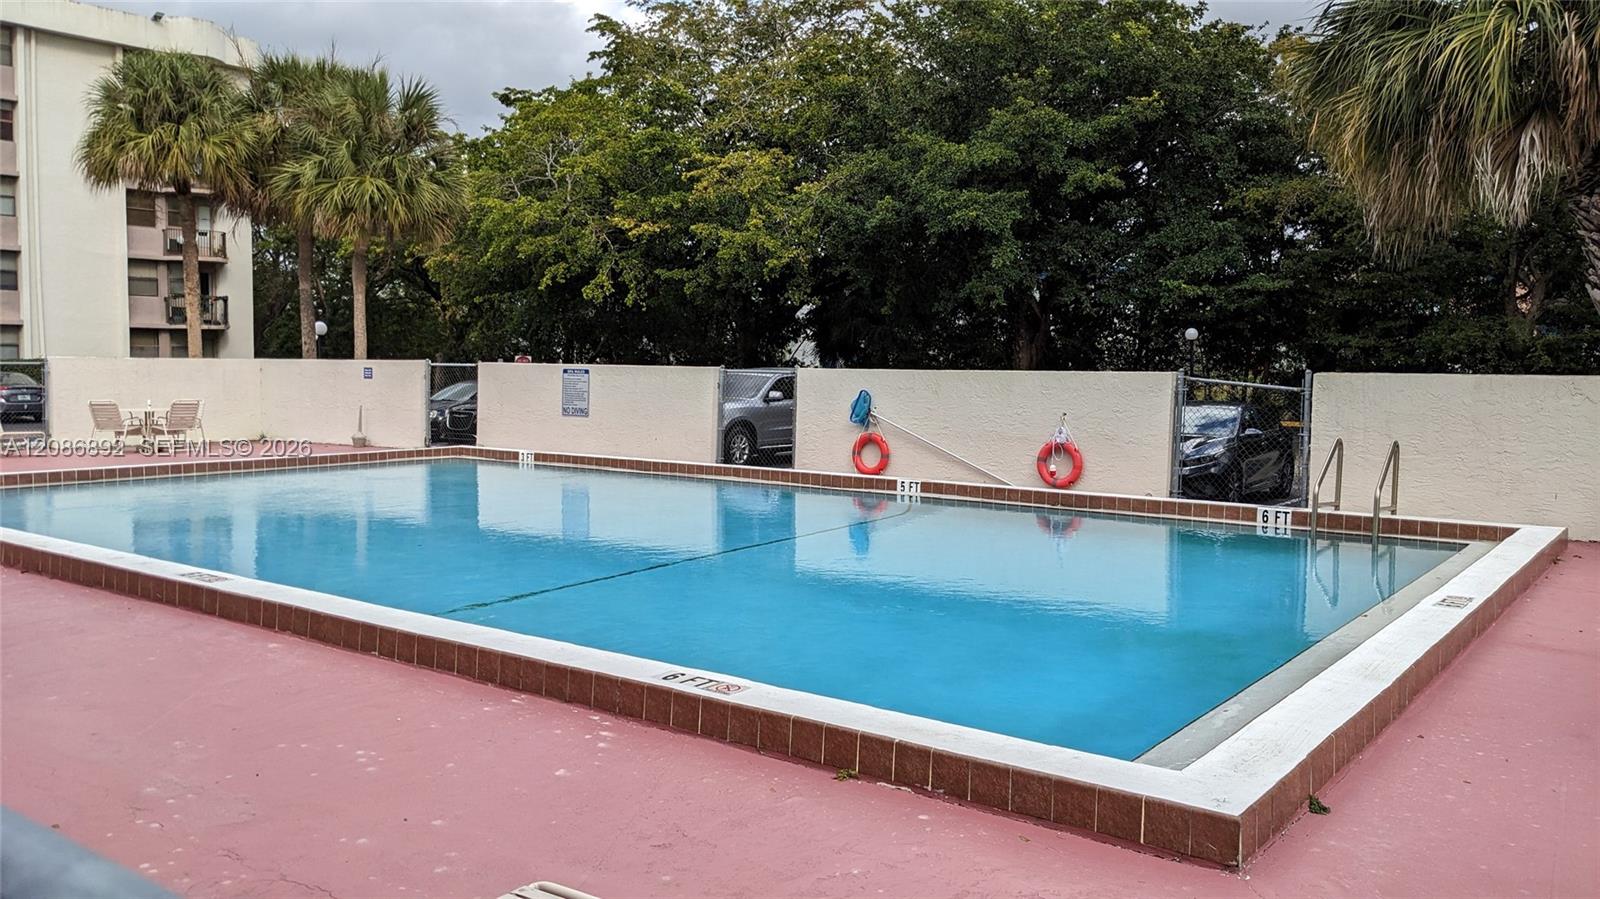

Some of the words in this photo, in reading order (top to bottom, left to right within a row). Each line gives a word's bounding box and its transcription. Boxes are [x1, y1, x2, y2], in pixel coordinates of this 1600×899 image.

[563, 407, 571, 415] NO
[571, 407, 589, 416] DIVING
[526, 452, 534, 462] FT
[900, 480, 906, 492] 5
[909, 481, 920, 493] FT
[1262, 509, 1269, 524] 6
[1275, 510, 1290, 525] FT
[661, 673, 686, 681] 6
[679, 676, 720, 687] FT
